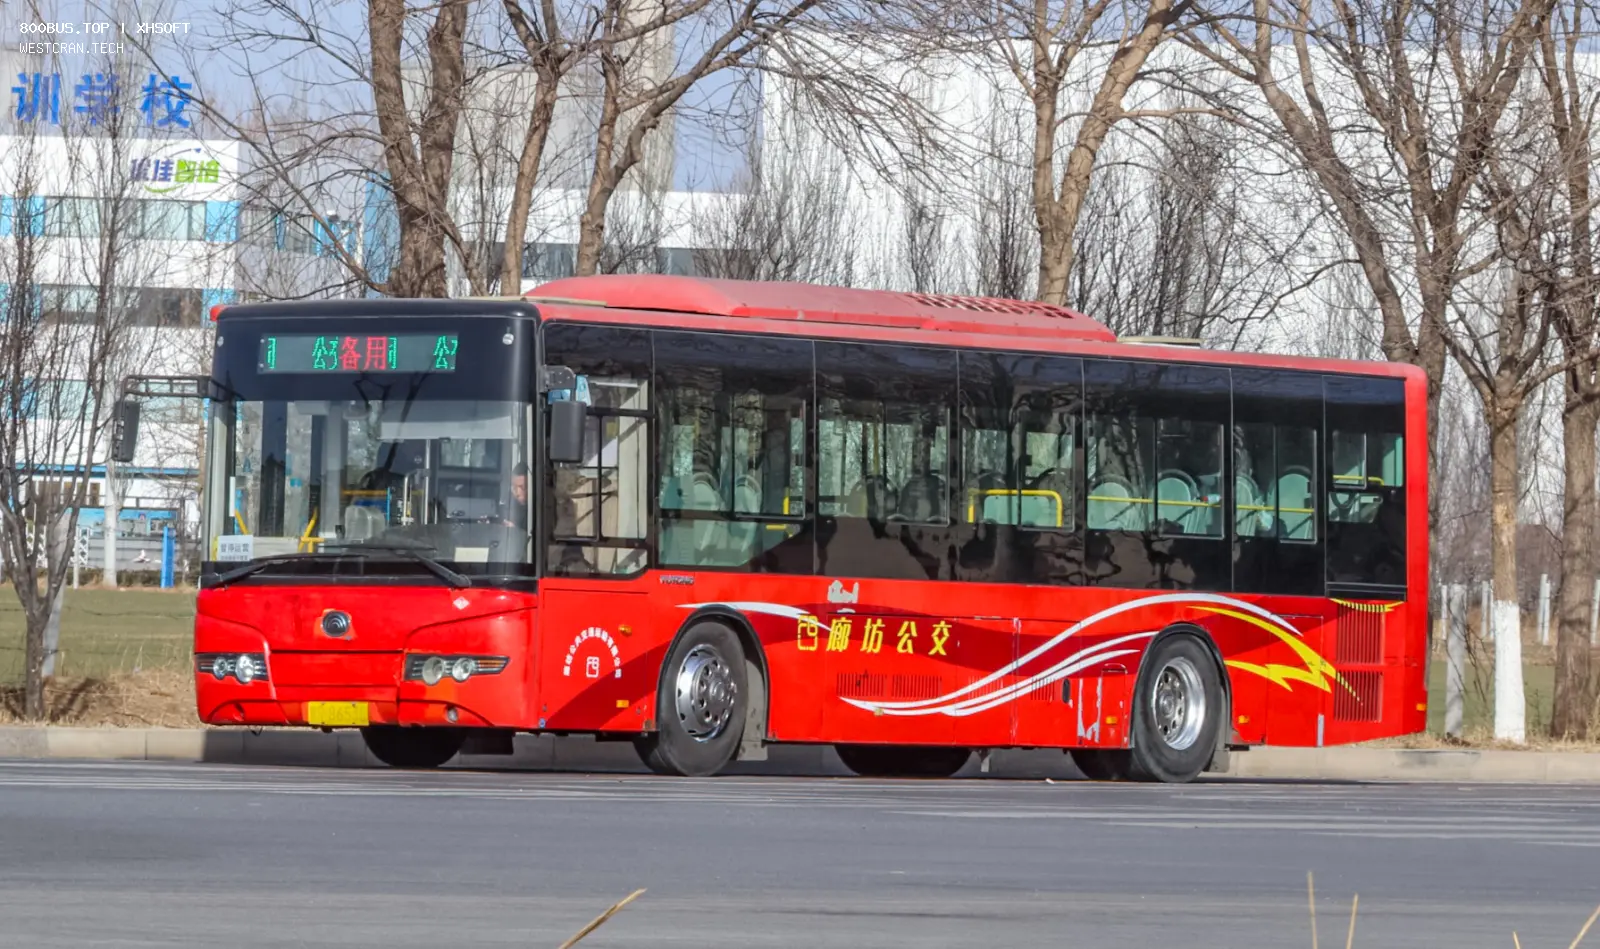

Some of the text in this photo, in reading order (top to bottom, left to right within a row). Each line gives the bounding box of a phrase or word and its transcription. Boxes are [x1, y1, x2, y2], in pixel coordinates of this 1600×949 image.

[11, 72, 193, 128] 训学校
[339, 336, 387, 370] 备用
[826, 617, 952, 656] 廊坊公交
